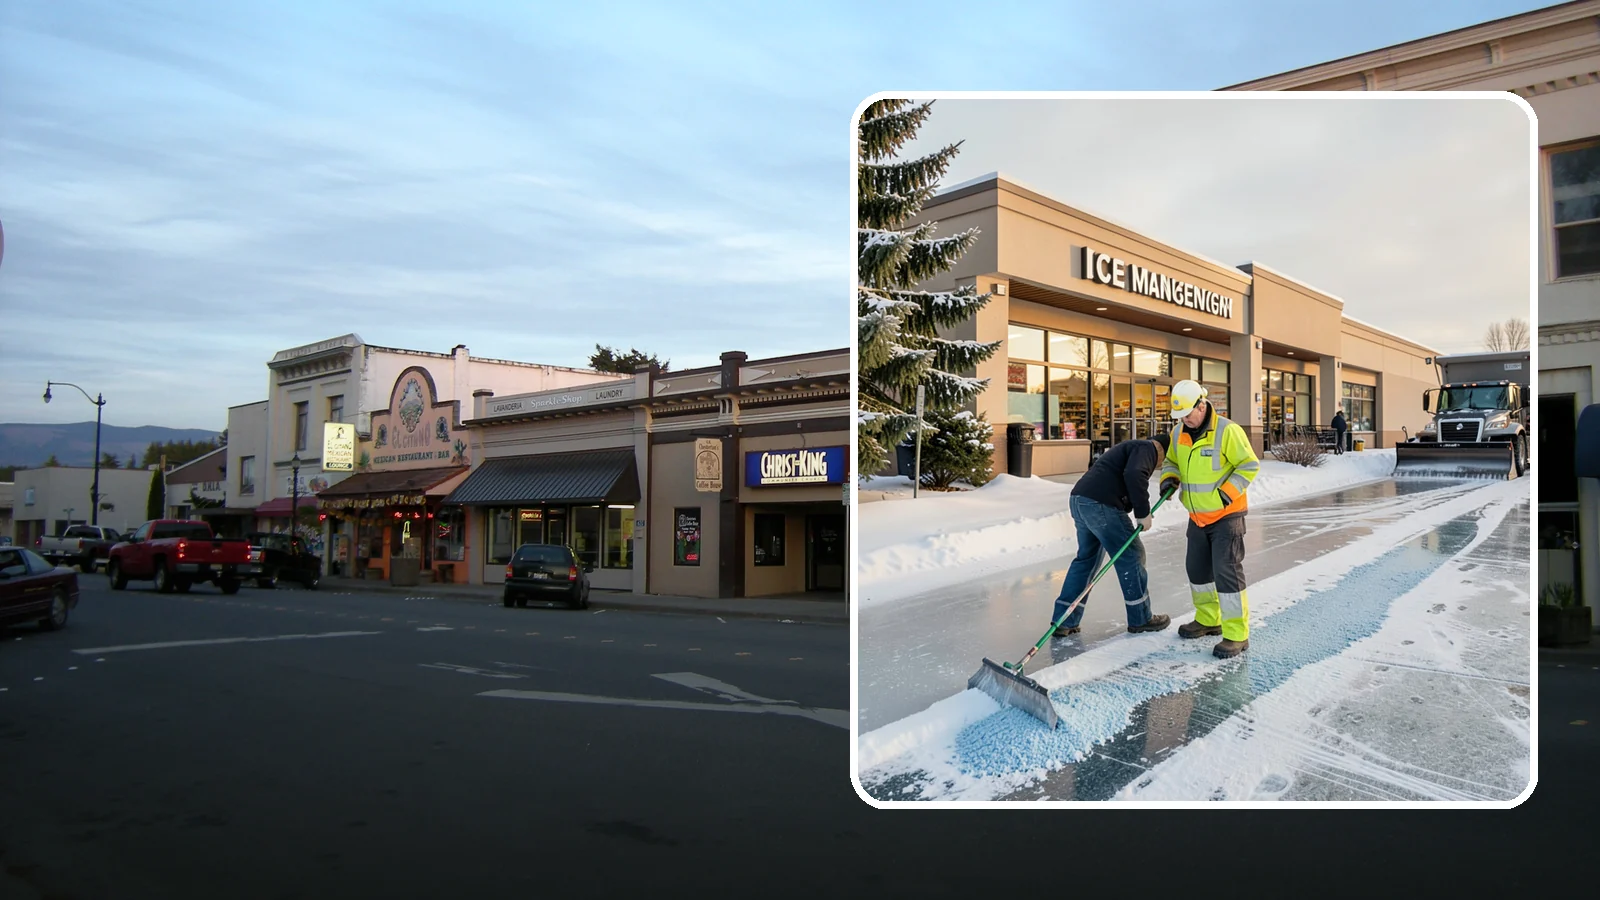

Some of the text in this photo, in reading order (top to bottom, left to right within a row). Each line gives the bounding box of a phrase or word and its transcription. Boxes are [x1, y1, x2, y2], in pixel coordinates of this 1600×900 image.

[1083, 246, 1125, 289] ICE
[493, 389, 624, 413] LAVANDERIA Sparkle Shop LAUNDRY
[373, 455, 396, 464] MEXICAN
[397, 452, 433, 462] RESTAURANT
[437, 450, 450, 459] BAR
[760, 450, 828, 478] CHRIST KING
[696, 481, 721, 489] Coffee House
